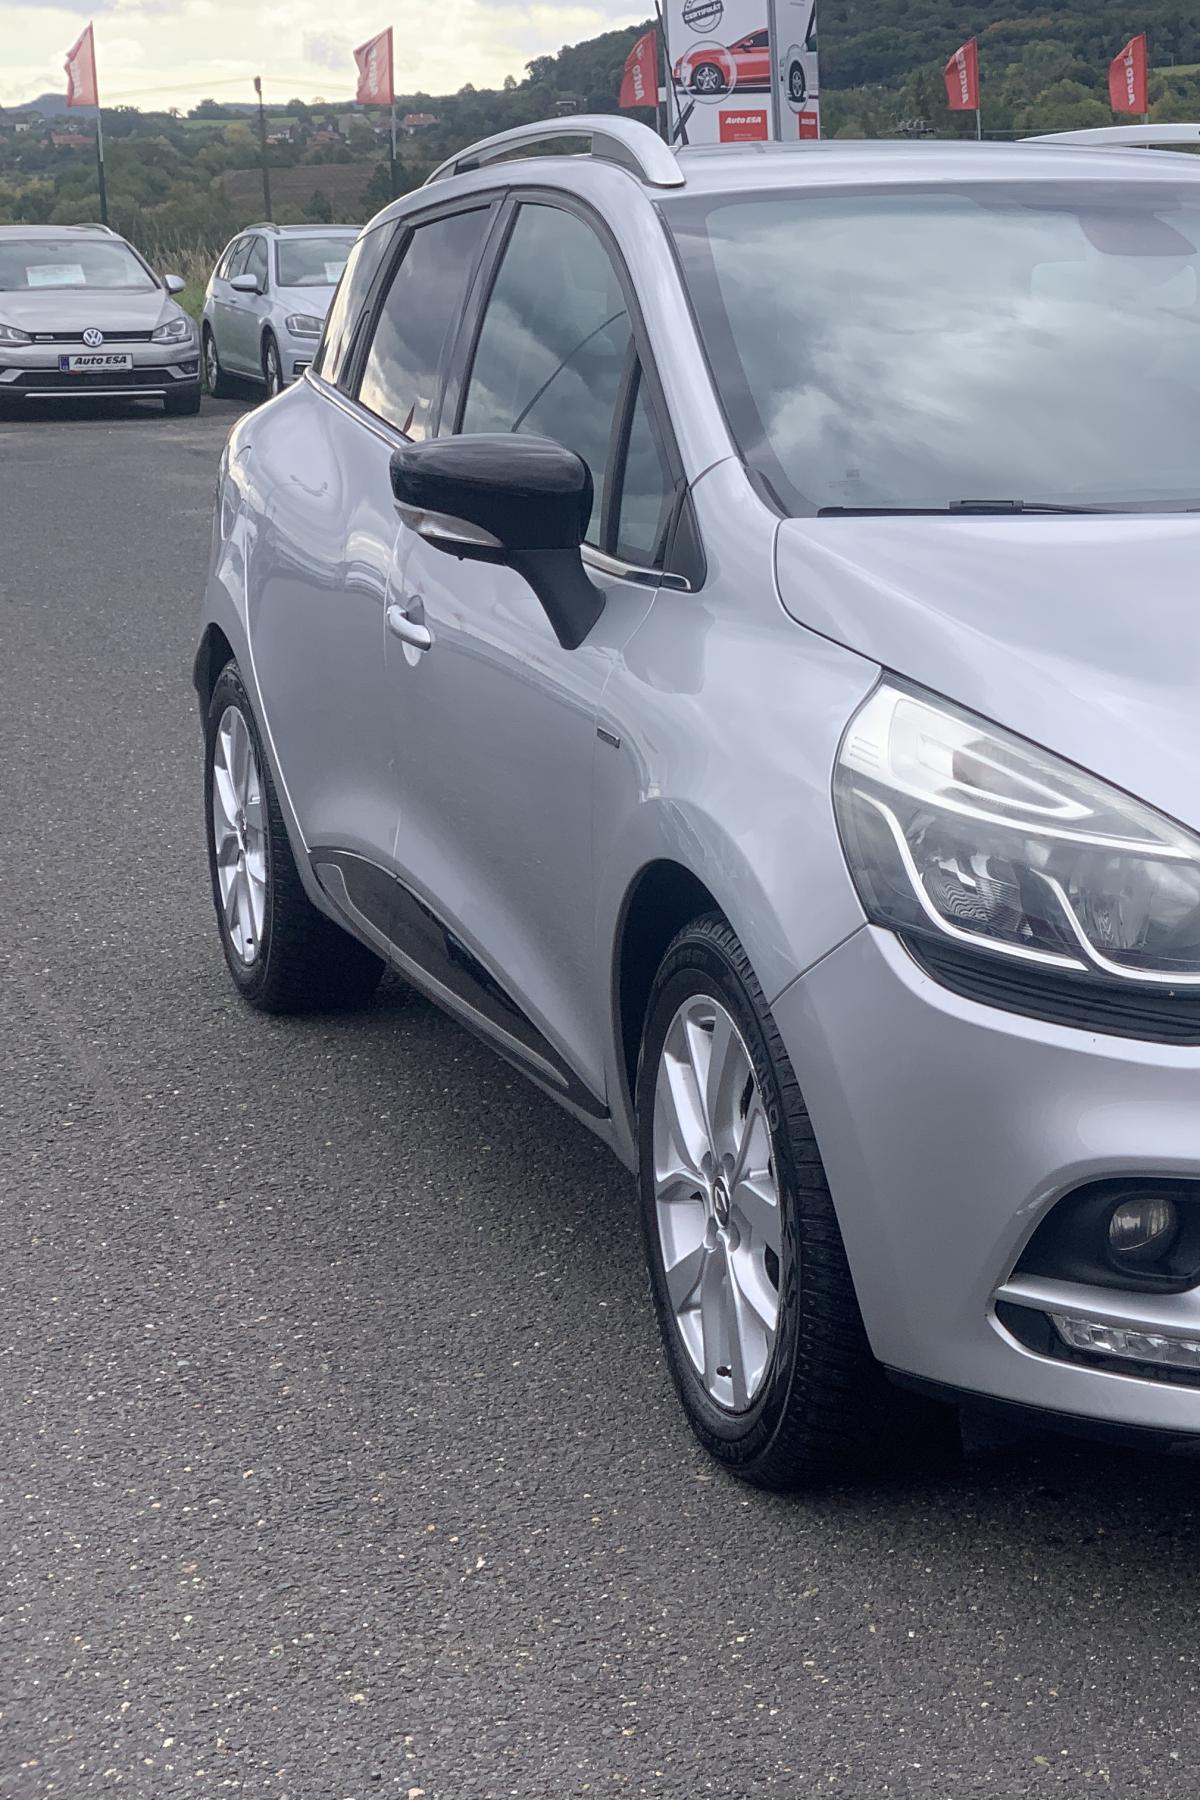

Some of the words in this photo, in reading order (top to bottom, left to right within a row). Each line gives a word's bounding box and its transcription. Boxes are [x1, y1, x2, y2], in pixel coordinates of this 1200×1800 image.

[746, 116, 762, 124] ESA
[74, 356, 103, 365] Auto
[105, 355, 127, 364] ESA
